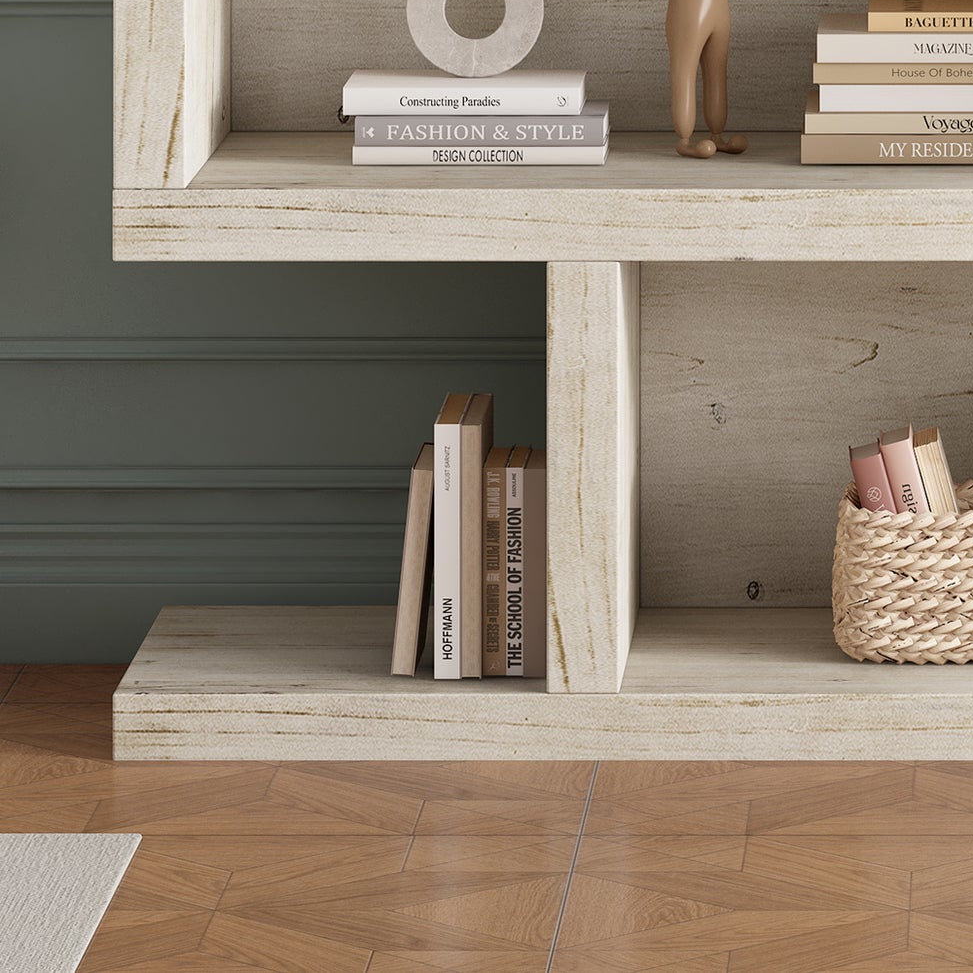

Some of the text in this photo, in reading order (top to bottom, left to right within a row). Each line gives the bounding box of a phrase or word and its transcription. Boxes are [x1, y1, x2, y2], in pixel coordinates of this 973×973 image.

[891, 68, 926, 78] House
[928, 68, 943, 78] Of
[399, 95, 501, 109] Constructing Paradies
[386, 124, 585, 141] FASHION & STYLE
[432, 149, 524, 163] DESIGN COLLECTION
[879, 142, 906, 158] MY
[486, 471, 500, 486] J.K.
[486, 487, 500, 518] ROWLING
[486, 520, 500, 545] HARRY
[486, 545, 500, 571] POTTER
[507, 507, 522, 669] THE SCHOOL OF FASHION
[441, 597, 454, 661] HOFFMANN
